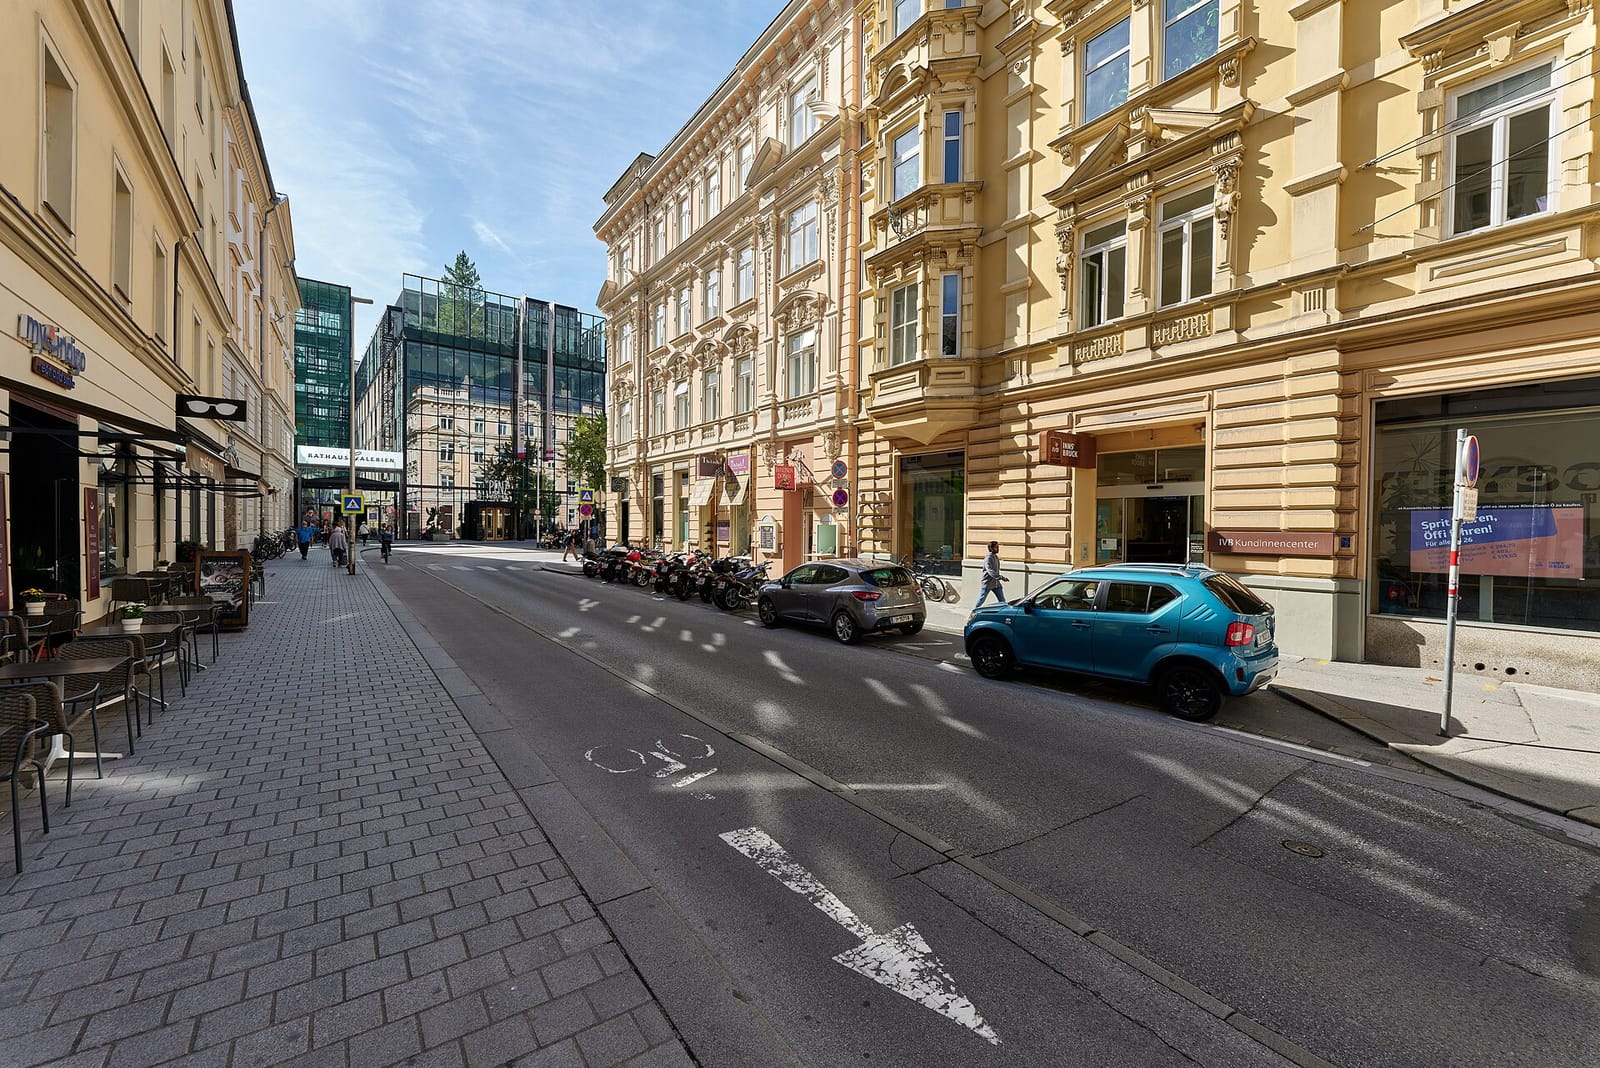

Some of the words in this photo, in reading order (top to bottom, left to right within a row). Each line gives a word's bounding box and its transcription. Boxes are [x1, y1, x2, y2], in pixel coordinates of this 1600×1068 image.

[307, 452, 350, 461] RATHAUS
[1062, 449, 1079, 458] BRUCK
[1421, 518, 1451, 530] Sprit
[1423, 529, 1447, 540] Öffi
[1219, 538, 1234, 546] IVB
[1235, 539, 1319, 549] KundInnencenter
